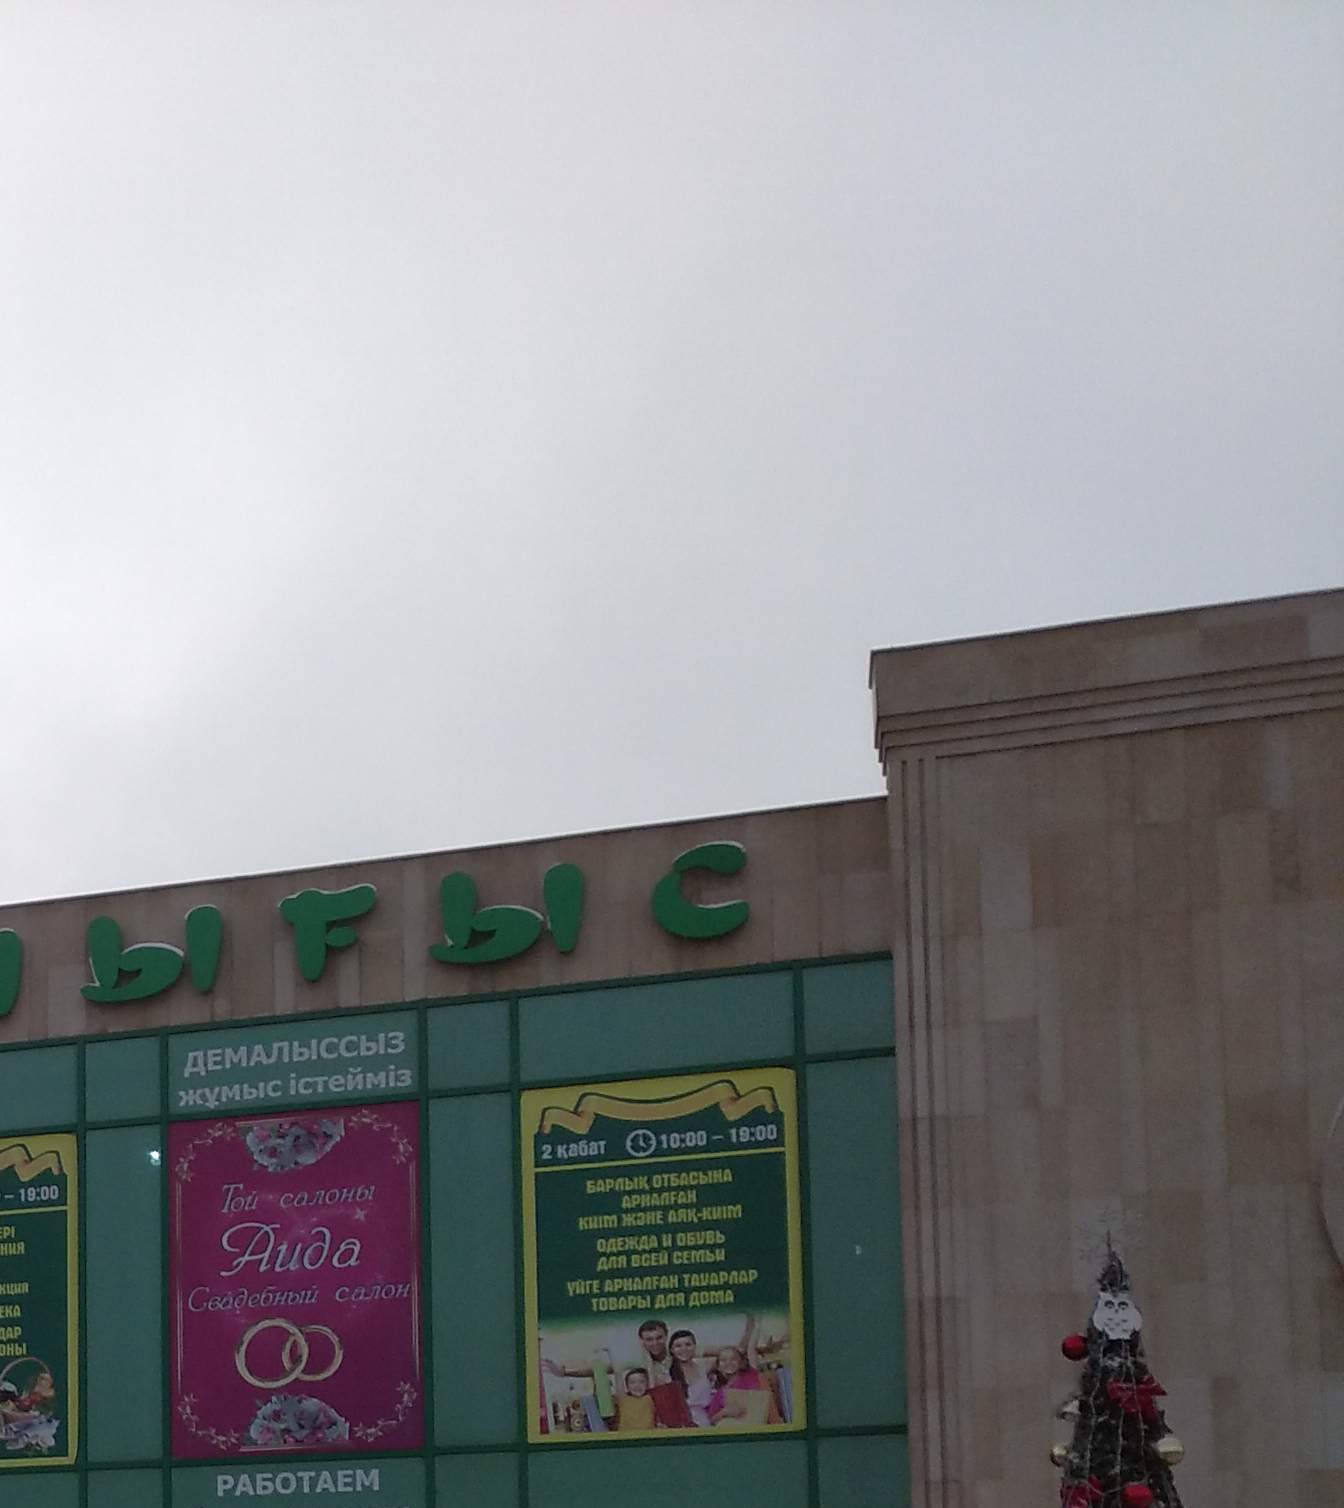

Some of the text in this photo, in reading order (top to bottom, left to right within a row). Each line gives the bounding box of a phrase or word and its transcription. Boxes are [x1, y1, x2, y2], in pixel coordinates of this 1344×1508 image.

[183, 1031, 406, 1078] ДЕМАЛЫССЫЗ
[289, 1065, 413, 1096] істейміз
[541, 1144, 553, 1160] 2
[661, 1130, 707, 1149] 10:00
[729, 1124, 777, 1143] 19:00
[19, 1185, 59, 1202] 19:00
[586, 1169, 733, 1194] БАРЛЫҚ ОТБАСЫНА
[279, 1184, 377, 1208] салоны
[622, 1190, 697, 1209] АРНАЛҒАН
[622, 1210, 664, 1227] ЖӘНЕ
[597, 1230, 725, 1253] ОДЕЖДА И ОБУВЬ
[597, 1254, 627, 1272] ДЛЯ
[673, 1248, 725, 1264] СЕМЬИ
[604, 1274, 678, 1292] АРНАЛҒАН
[683, 1269, 758, 1286] ТАУАРЛАР
[187, 1283, 411, 1313] Свадебный салон
[592, 1290, 734, 1311] ТОВАРЫ ДЛЯ ДОМА
[216, 1469, 381, 1497] РАБОТАЕМ
